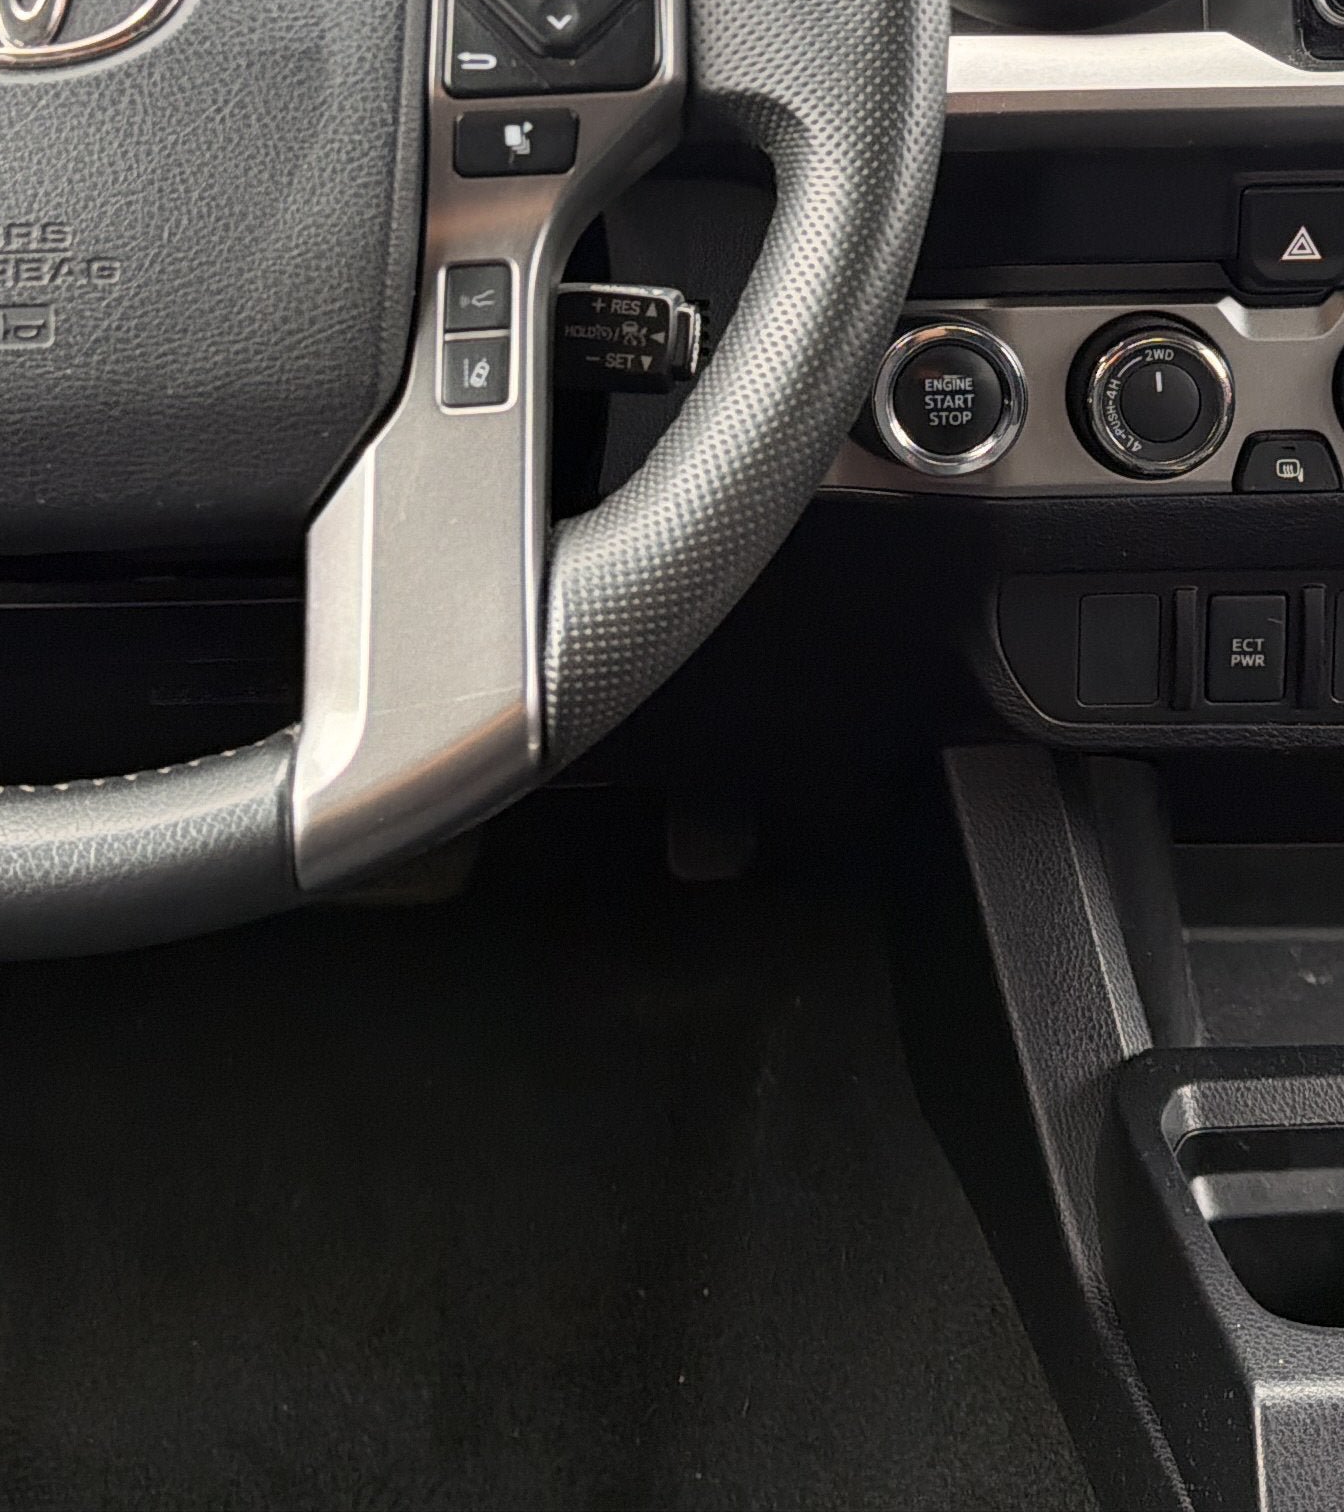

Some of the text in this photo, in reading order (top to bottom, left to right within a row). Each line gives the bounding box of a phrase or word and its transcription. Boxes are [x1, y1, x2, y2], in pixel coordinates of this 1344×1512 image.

[611, 299, 641, 315] RES
[605, 353, 635, 369] SET
[1145, 349, 1175, 362] 2WD
[924, 377, 973, 391] ENGINE
[924, 394, 975, 410] START
[929, 411, 972, 426] STOP
[1232, 638, 1265, 652] ECT
[1230, 654, 1265, 667] PWR
